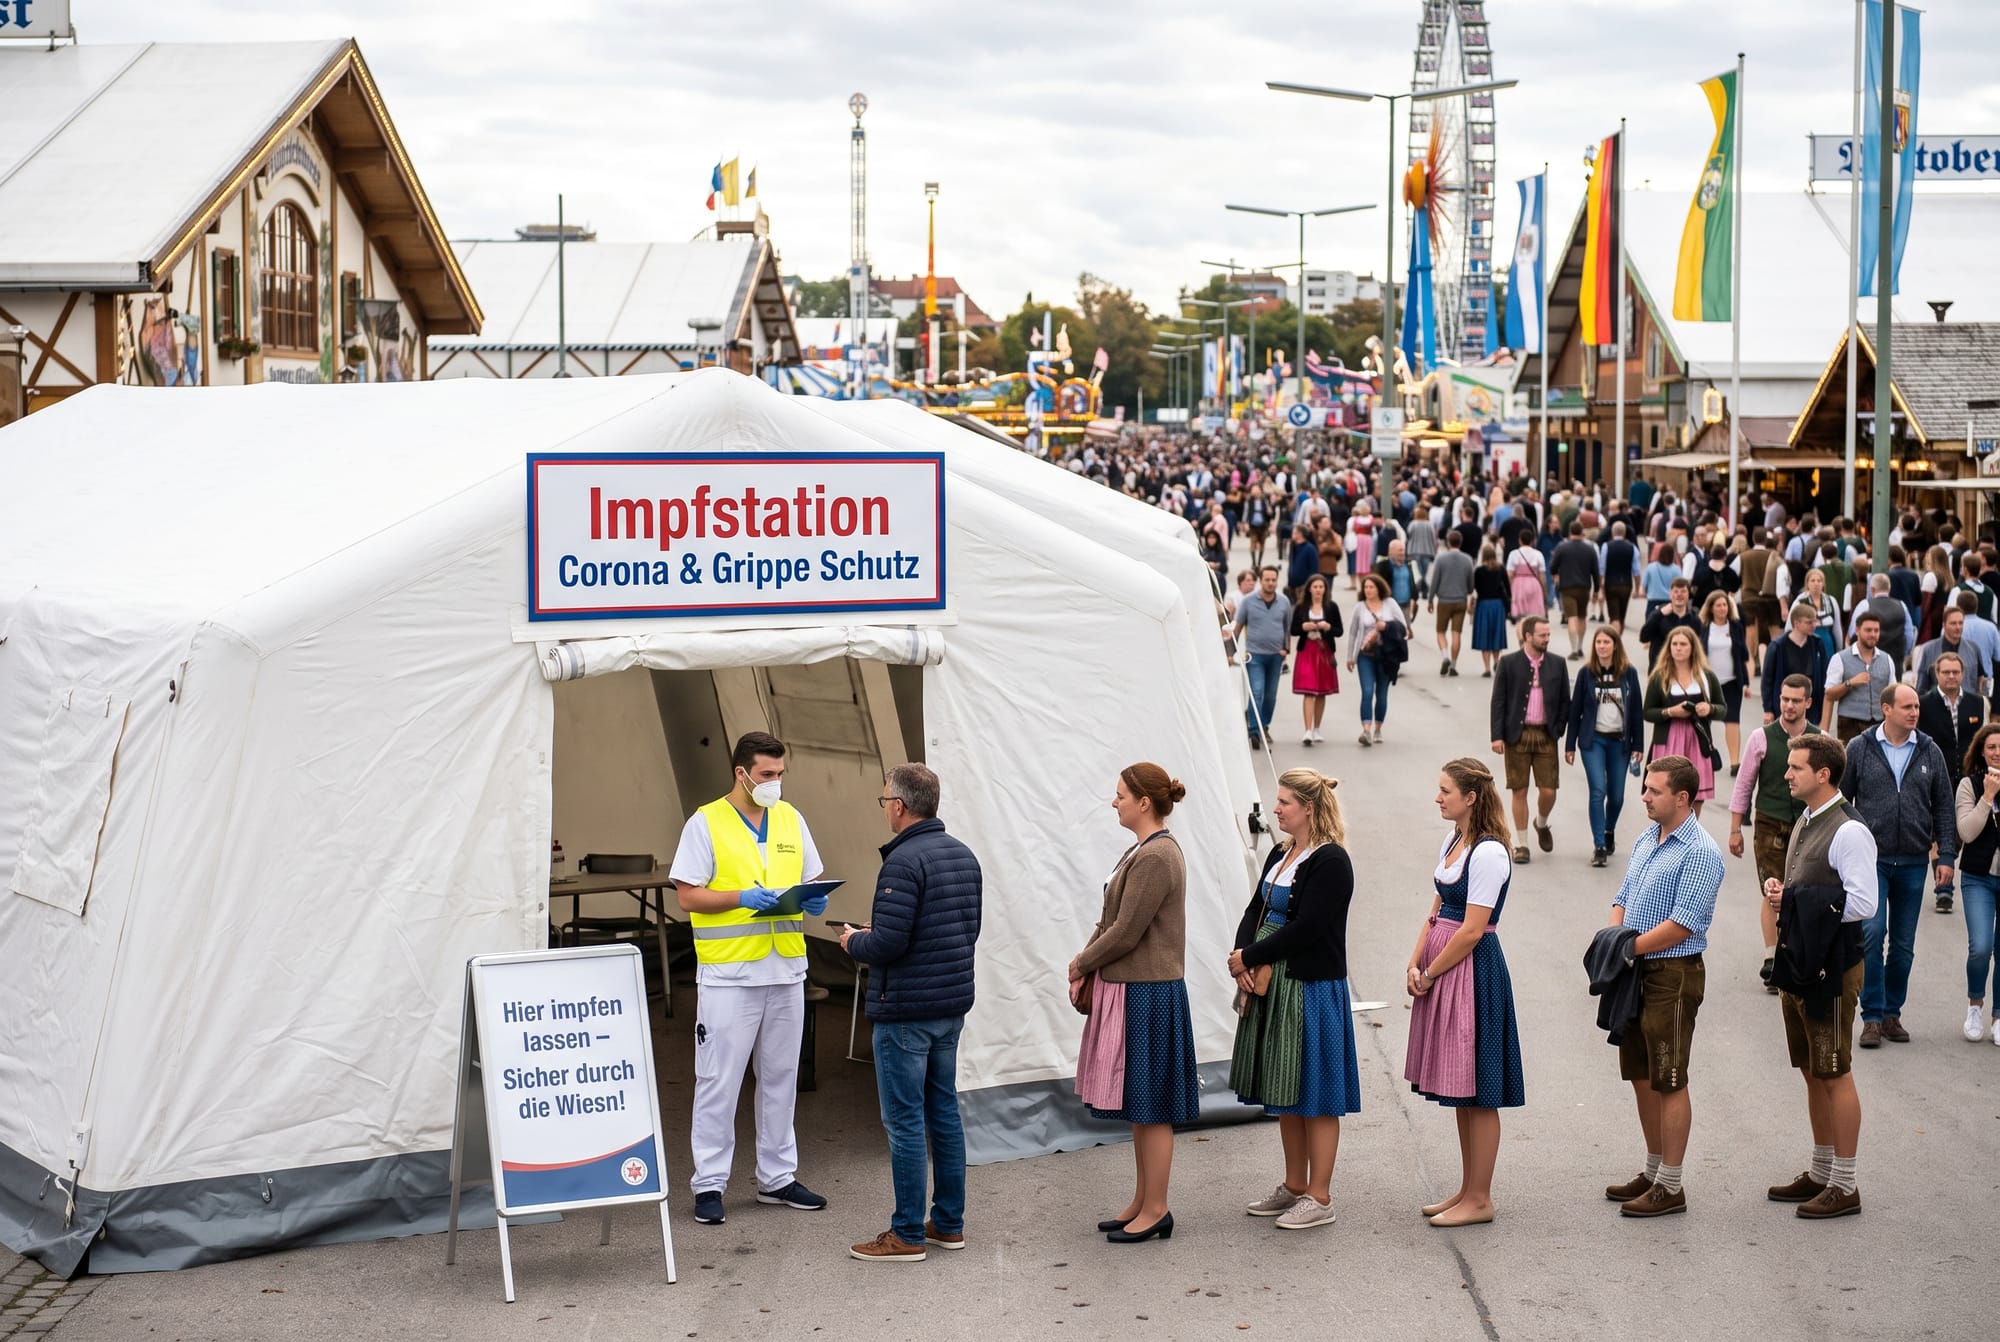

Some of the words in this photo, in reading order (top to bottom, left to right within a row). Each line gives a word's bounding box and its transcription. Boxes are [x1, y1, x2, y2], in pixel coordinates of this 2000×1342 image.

[590, 485, 889, 551] Impfstation
[558, 554, 669, 588] Corona
[679, 552, 703, 585] &
[712, 551, 811, 590] Grippe
[820, 549, 920, 582] Schutz
[502, 1000, 545, 1024] Hier
[550, 996, 623, 1023] impfen
[523, 1031, 591, 1053] lassen
[503, 1066, 570, 1091] Sicher
[575, 1059, 635, 1084] durch
[518, 1097, 551, 1120] die
[554, 1089, 626, 1117] Wiesn!
